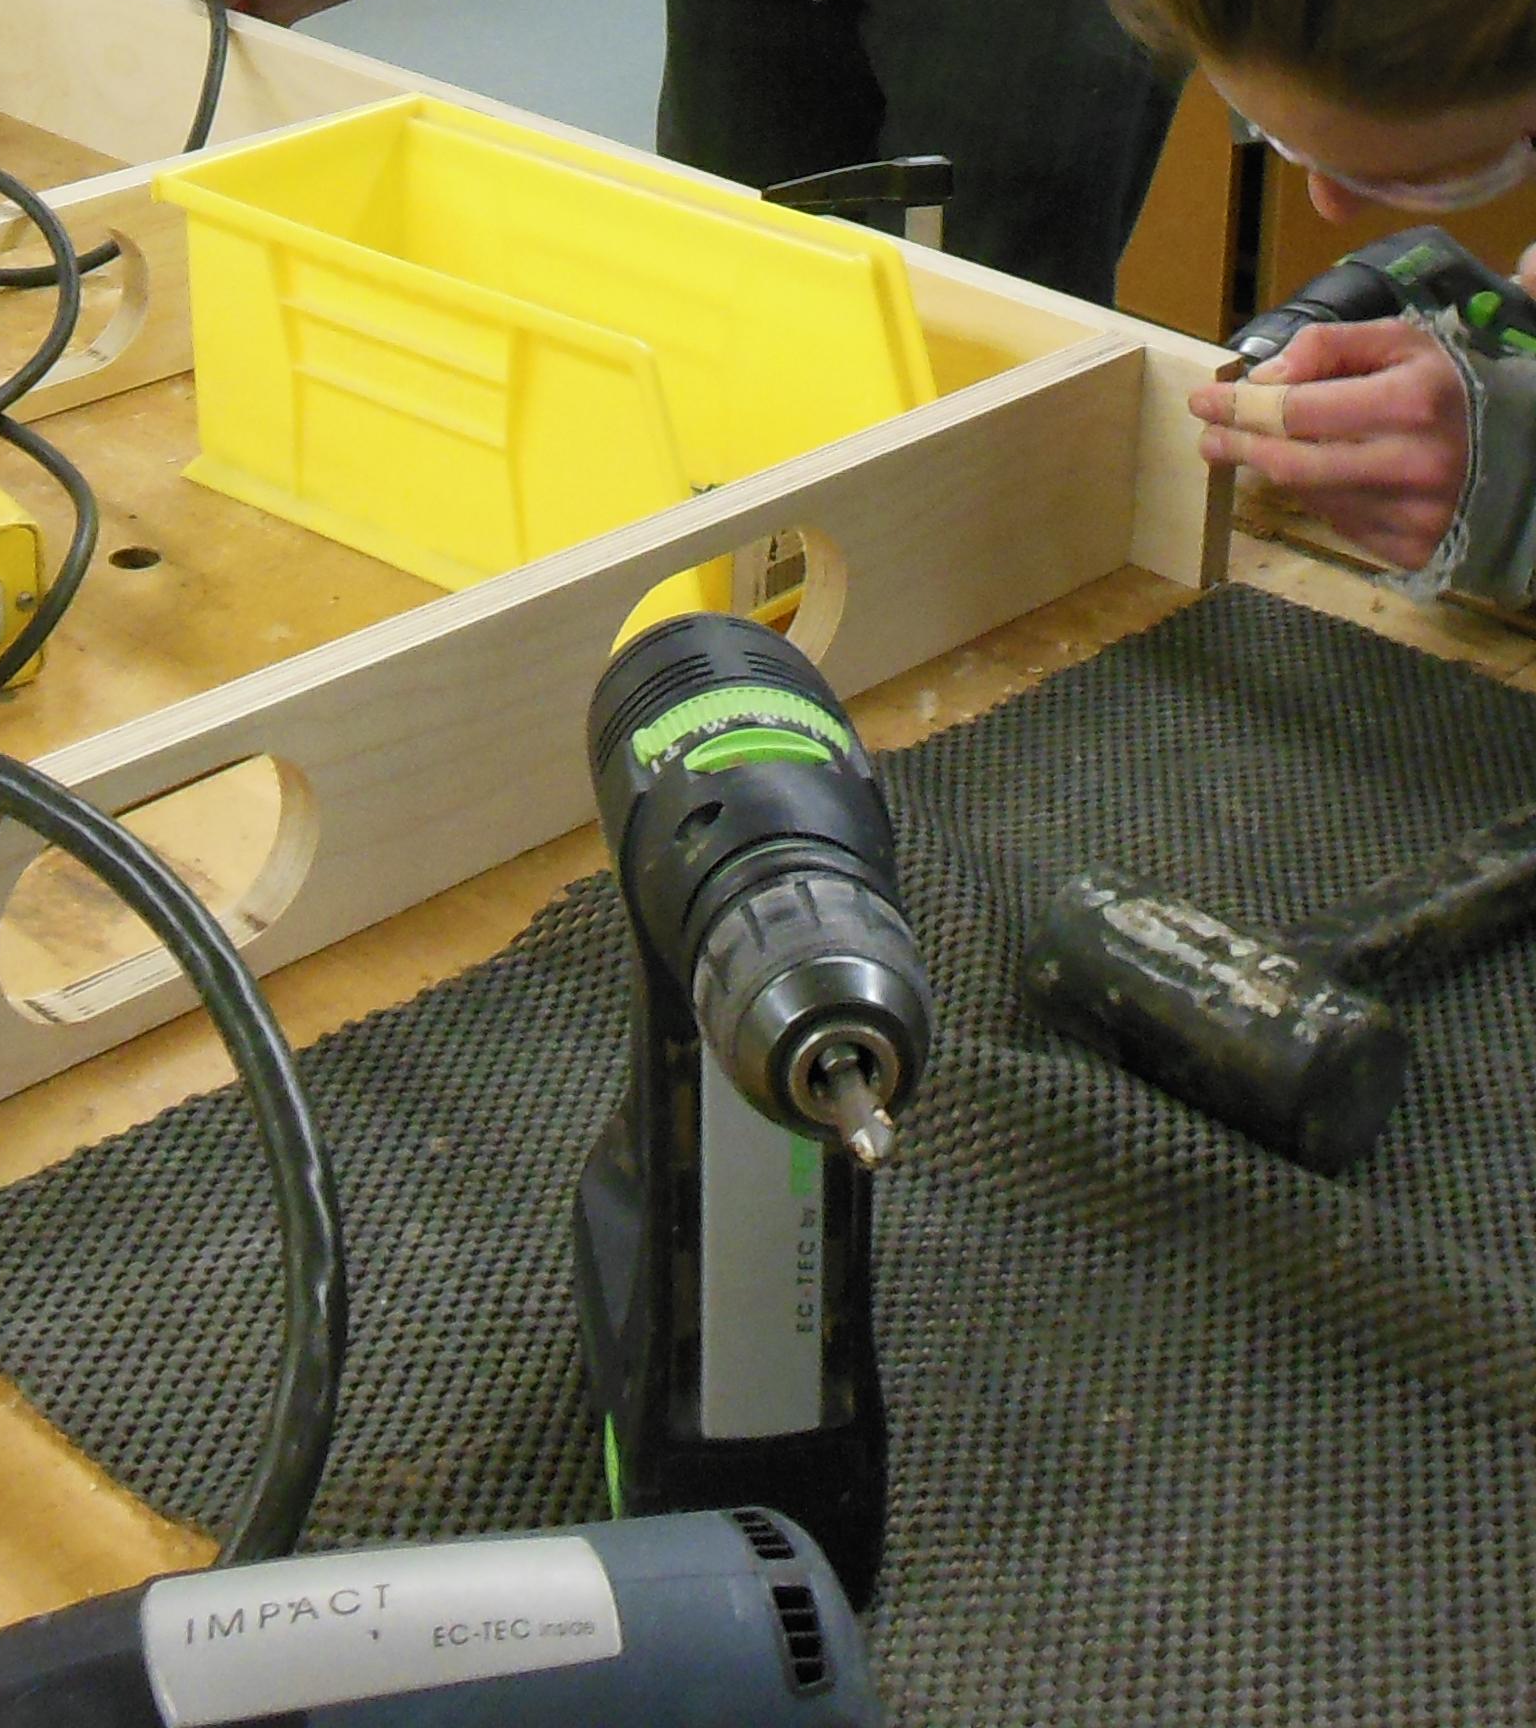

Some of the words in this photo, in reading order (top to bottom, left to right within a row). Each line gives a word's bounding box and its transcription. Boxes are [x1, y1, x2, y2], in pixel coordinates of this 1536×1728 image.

[797, 1240, 816, 1333] EC-TEC
[185, 1583, 390, 1645] IMPACT
[432, 1618, 531, 1648] EC-TEC
